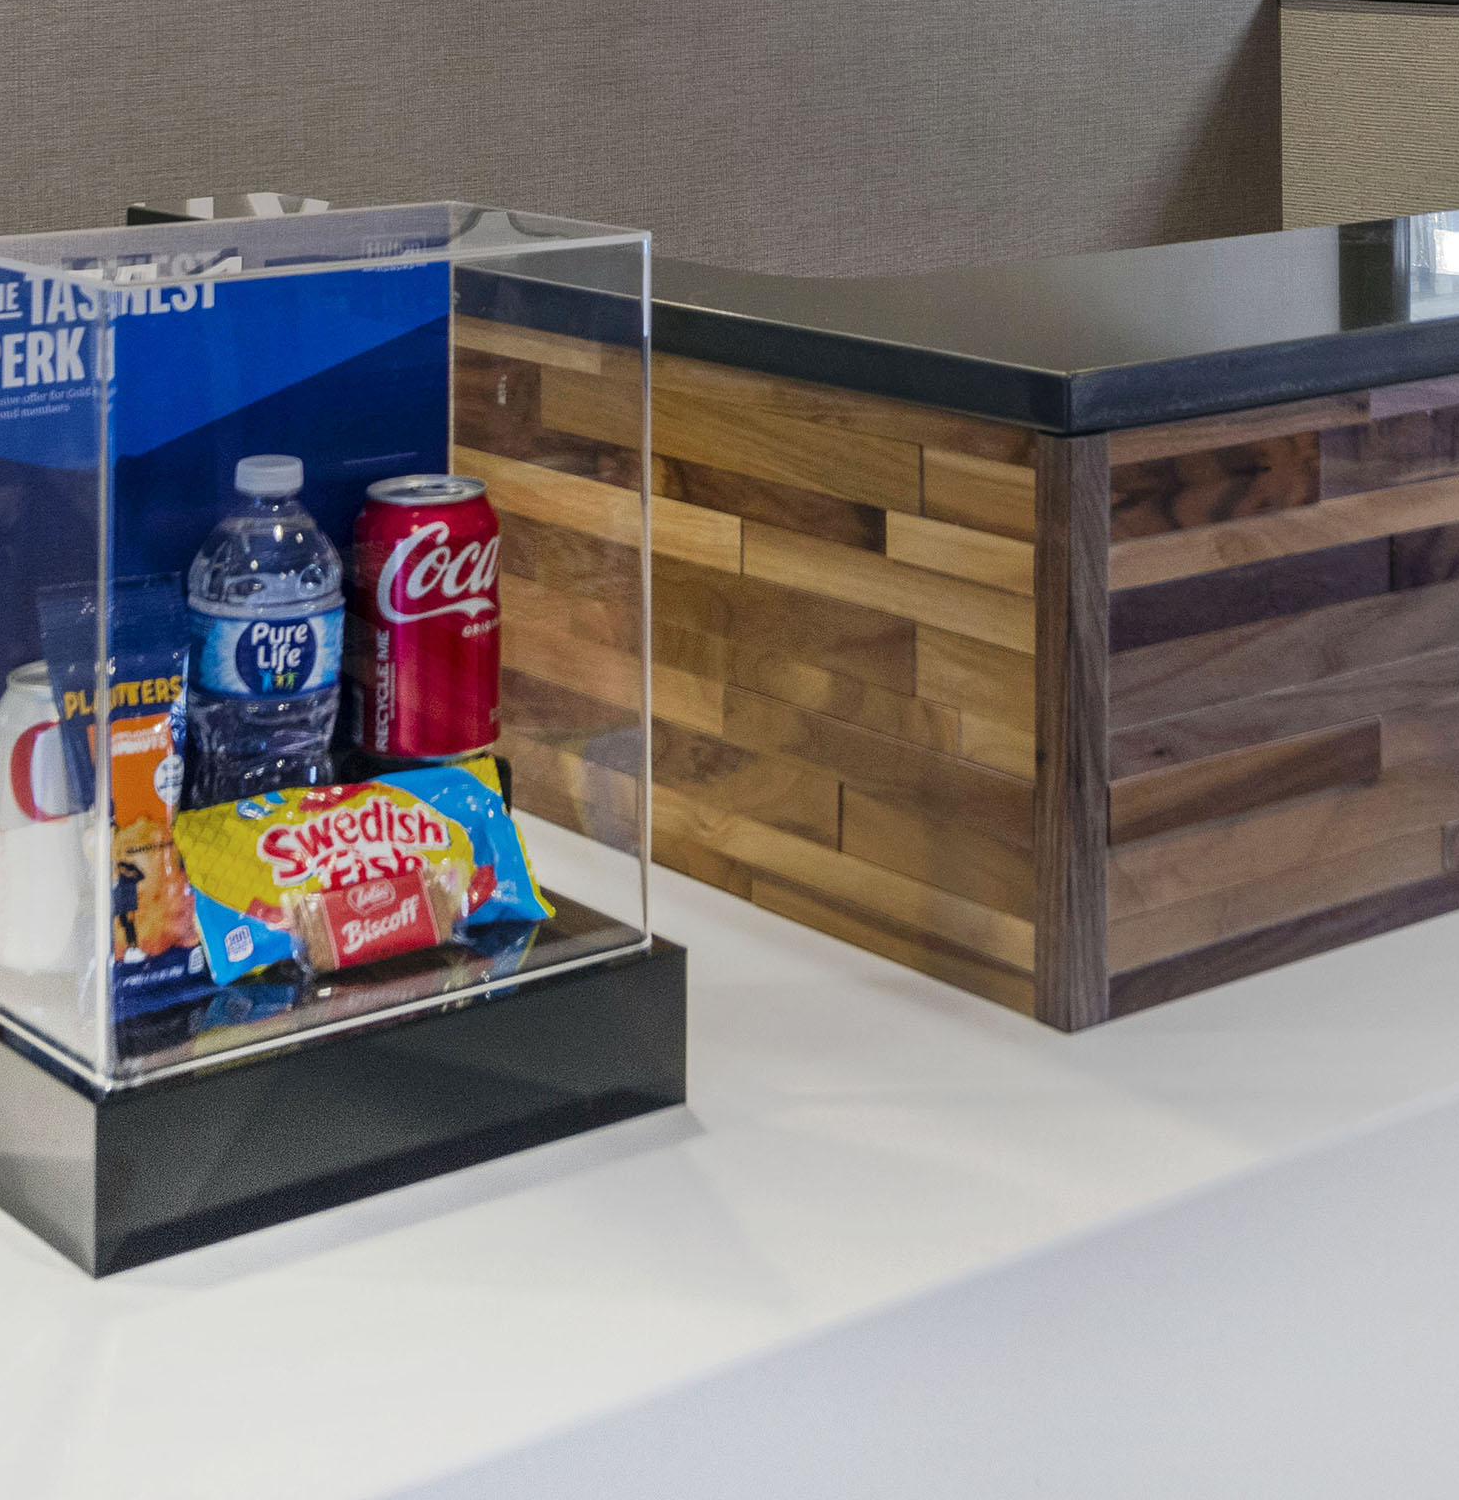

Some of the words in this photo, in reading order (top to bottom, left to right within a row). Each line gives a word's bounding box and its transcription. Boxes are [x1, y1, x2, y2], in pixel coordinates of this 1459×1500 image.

[24, 254, 219, 326] TASIEST
[49, 388, 67, 401] for
[376, 520, 501, 624] Coca
[251, 621, 309, 647] Pure
[375, 629, 391, 661] ME
[257, 643, 302, 675] Life
[62, 674, 183, 720] PLTERS
[374, 662, 390, 753] RECYCLE
[260, 797, 446, 882] Swedish
[315, 847, 426, 891] Fish
[341, 893, 420, 955] Biscoff
